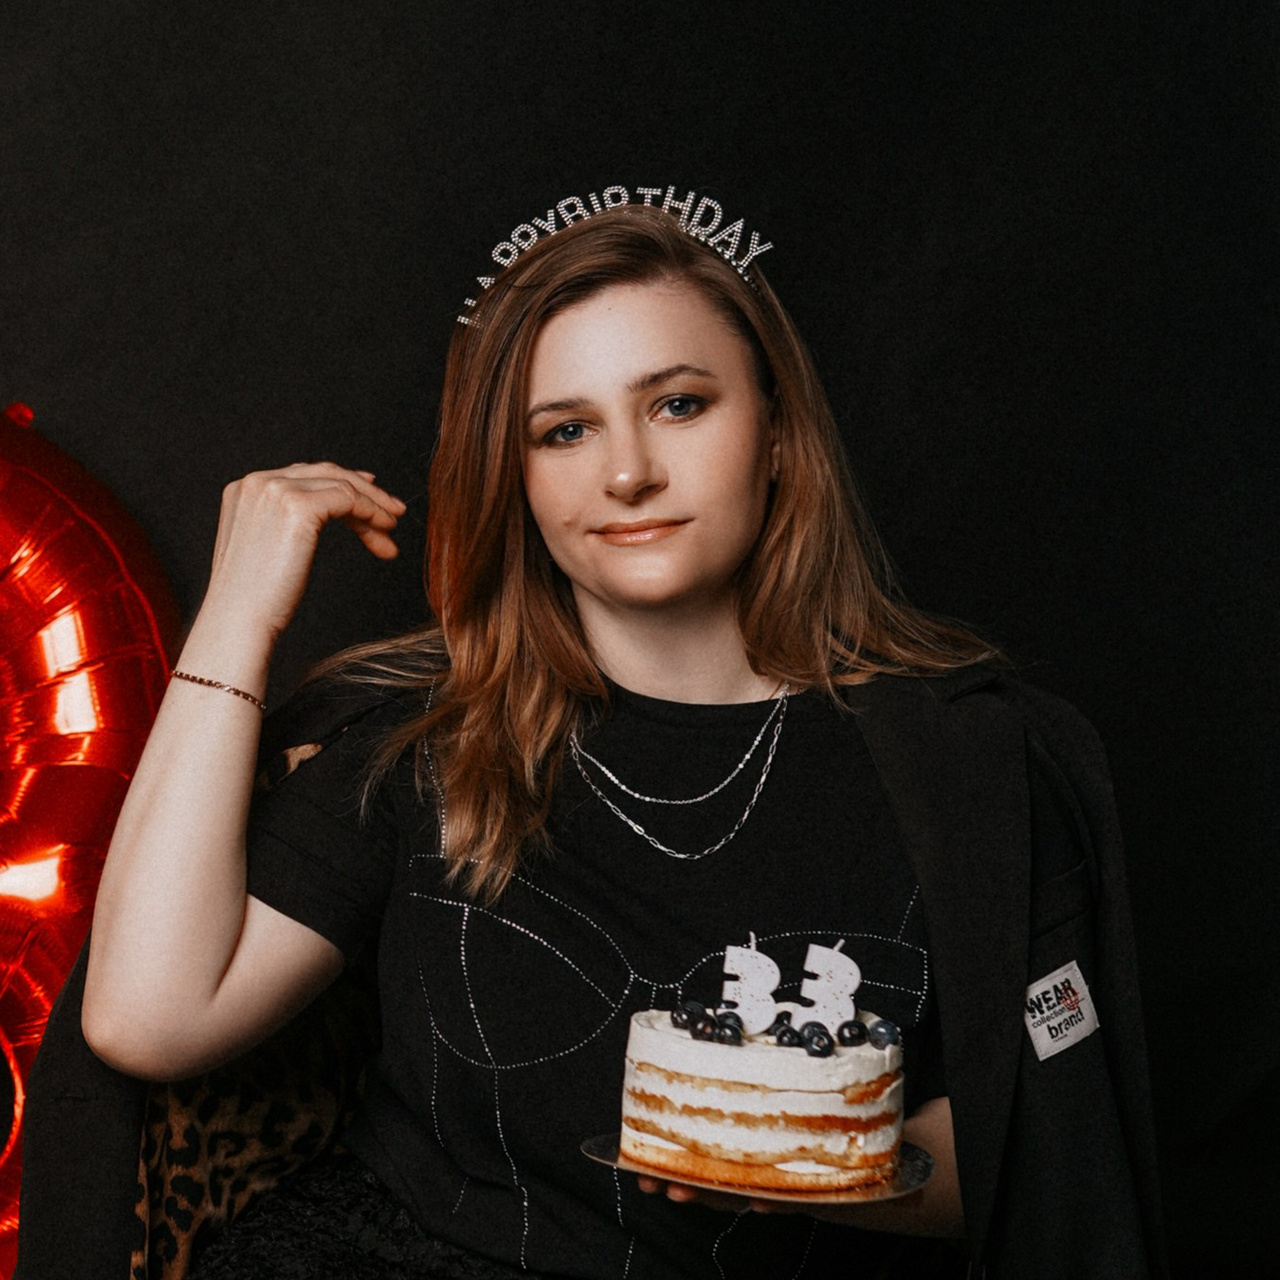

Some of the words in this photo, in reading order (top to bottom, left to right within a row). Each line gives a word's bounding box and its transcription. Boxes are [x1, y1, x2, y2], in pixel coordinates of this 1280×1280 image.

[1024, 978, 1078, 1020] WEAR
[1031, 1006, 1067, 1029] collection
[1046, 1006, 1086, 1040] brand
